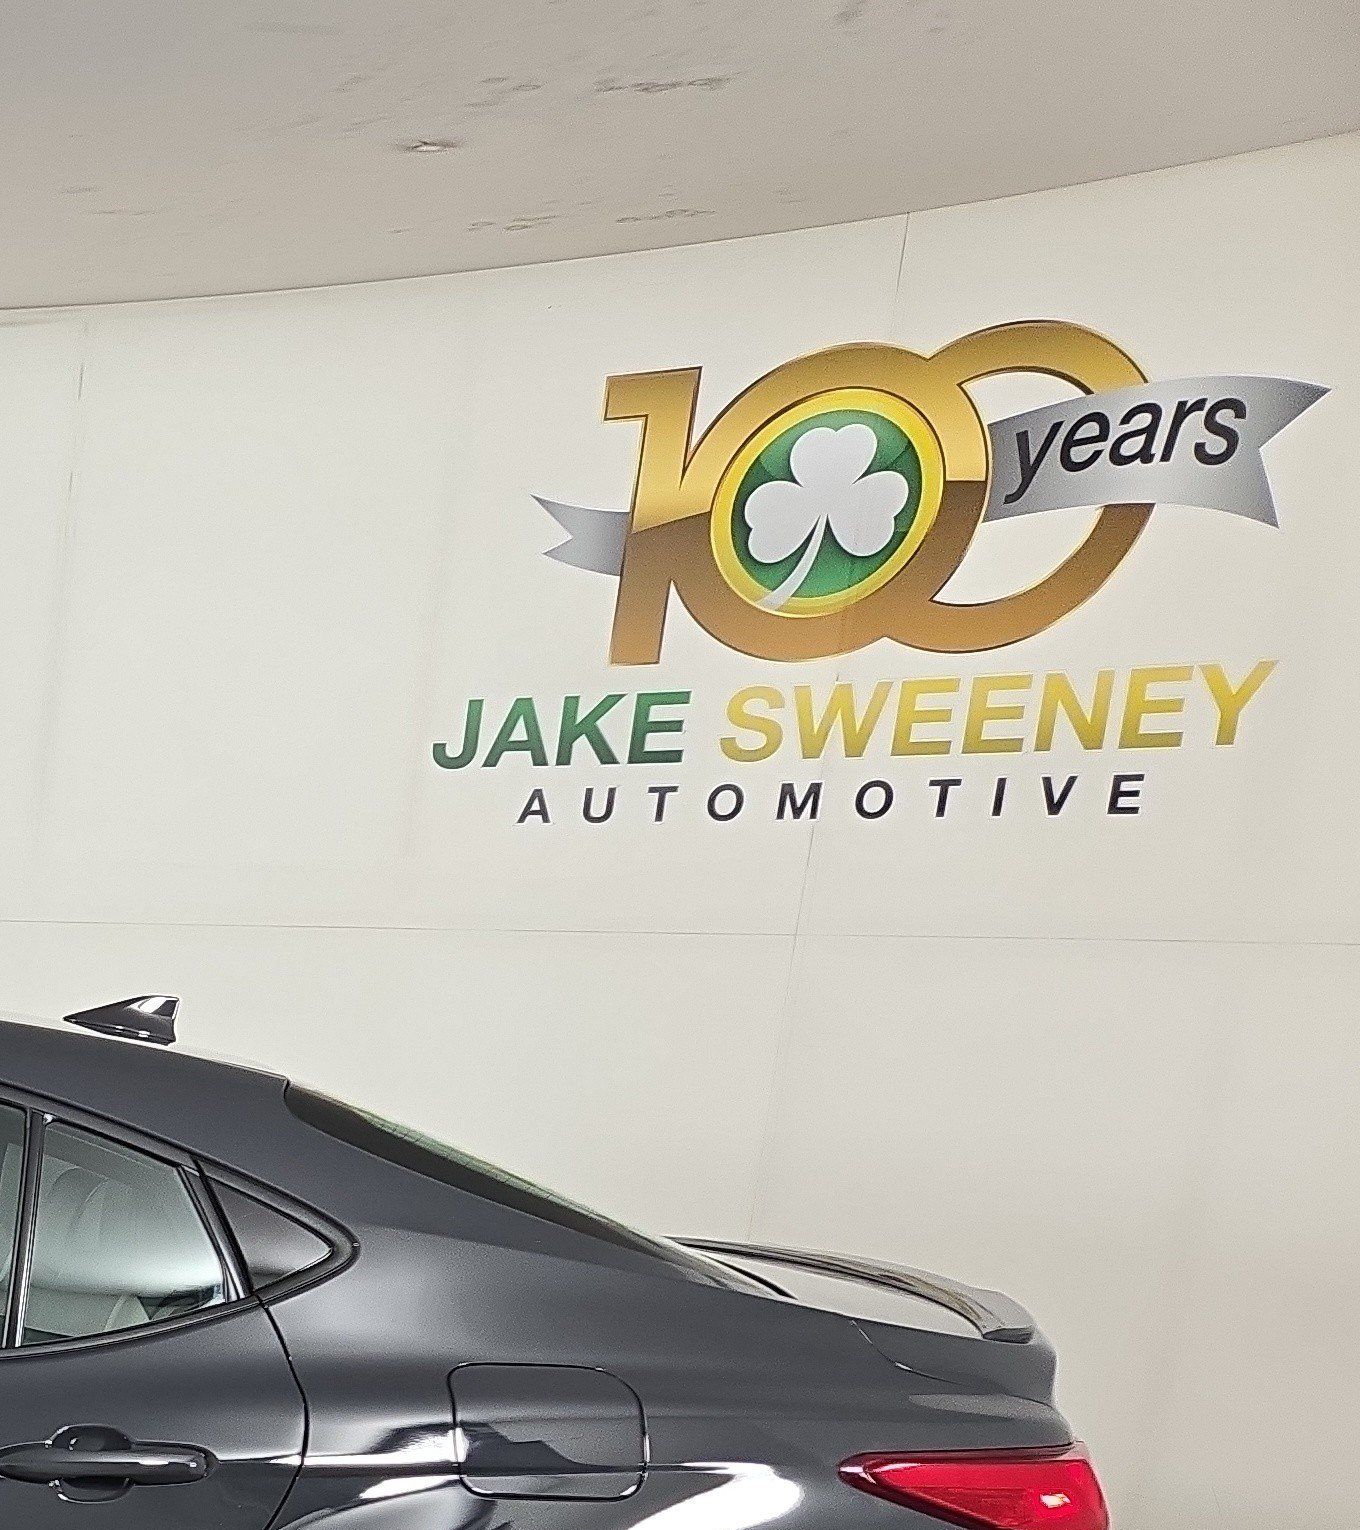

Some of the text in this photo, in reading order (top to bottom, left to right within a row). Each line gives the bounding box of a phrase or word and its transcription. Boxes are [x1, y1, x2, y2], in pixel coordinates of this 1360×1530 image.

[603, 319, 1155, 667] 100
[1003, 395, 1247, 505] years
[431, 660, 1278, 770] JAKE SWEENEY
[518, 773, 1146, 825] AUTOMOTIVE
